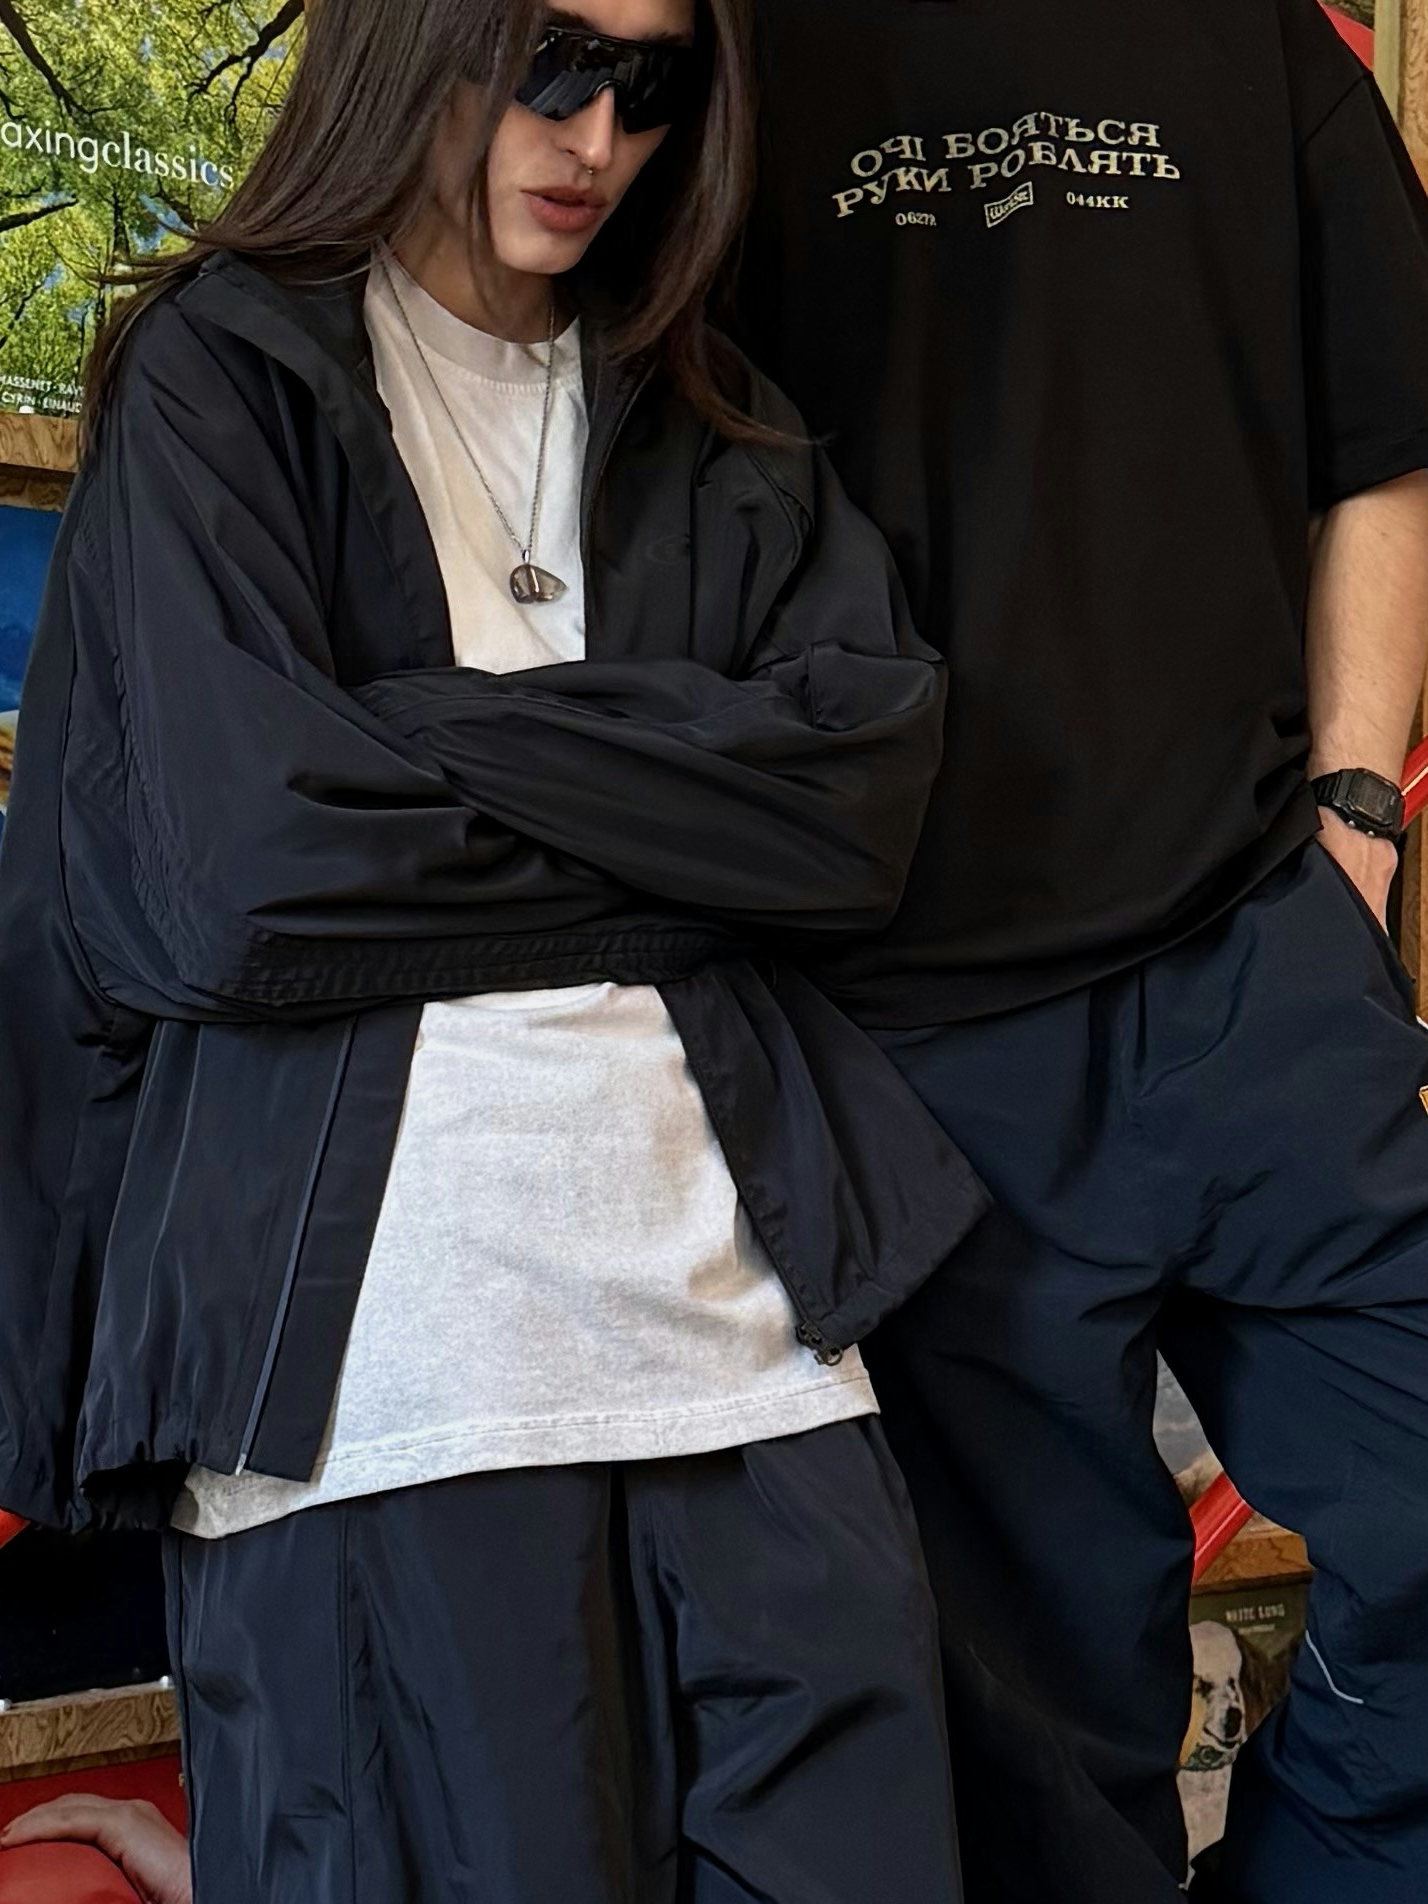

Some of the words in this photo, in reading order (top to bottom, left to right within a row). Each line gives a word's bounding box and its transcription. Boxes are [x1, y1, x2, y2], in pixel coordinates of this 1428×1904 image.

[942, 112, 1161, 160] БОЯТЬСЯ
[832, 166, 952, 218] РУКИ
[968, 141, 1181, 190] РОБЛЯТЬ
